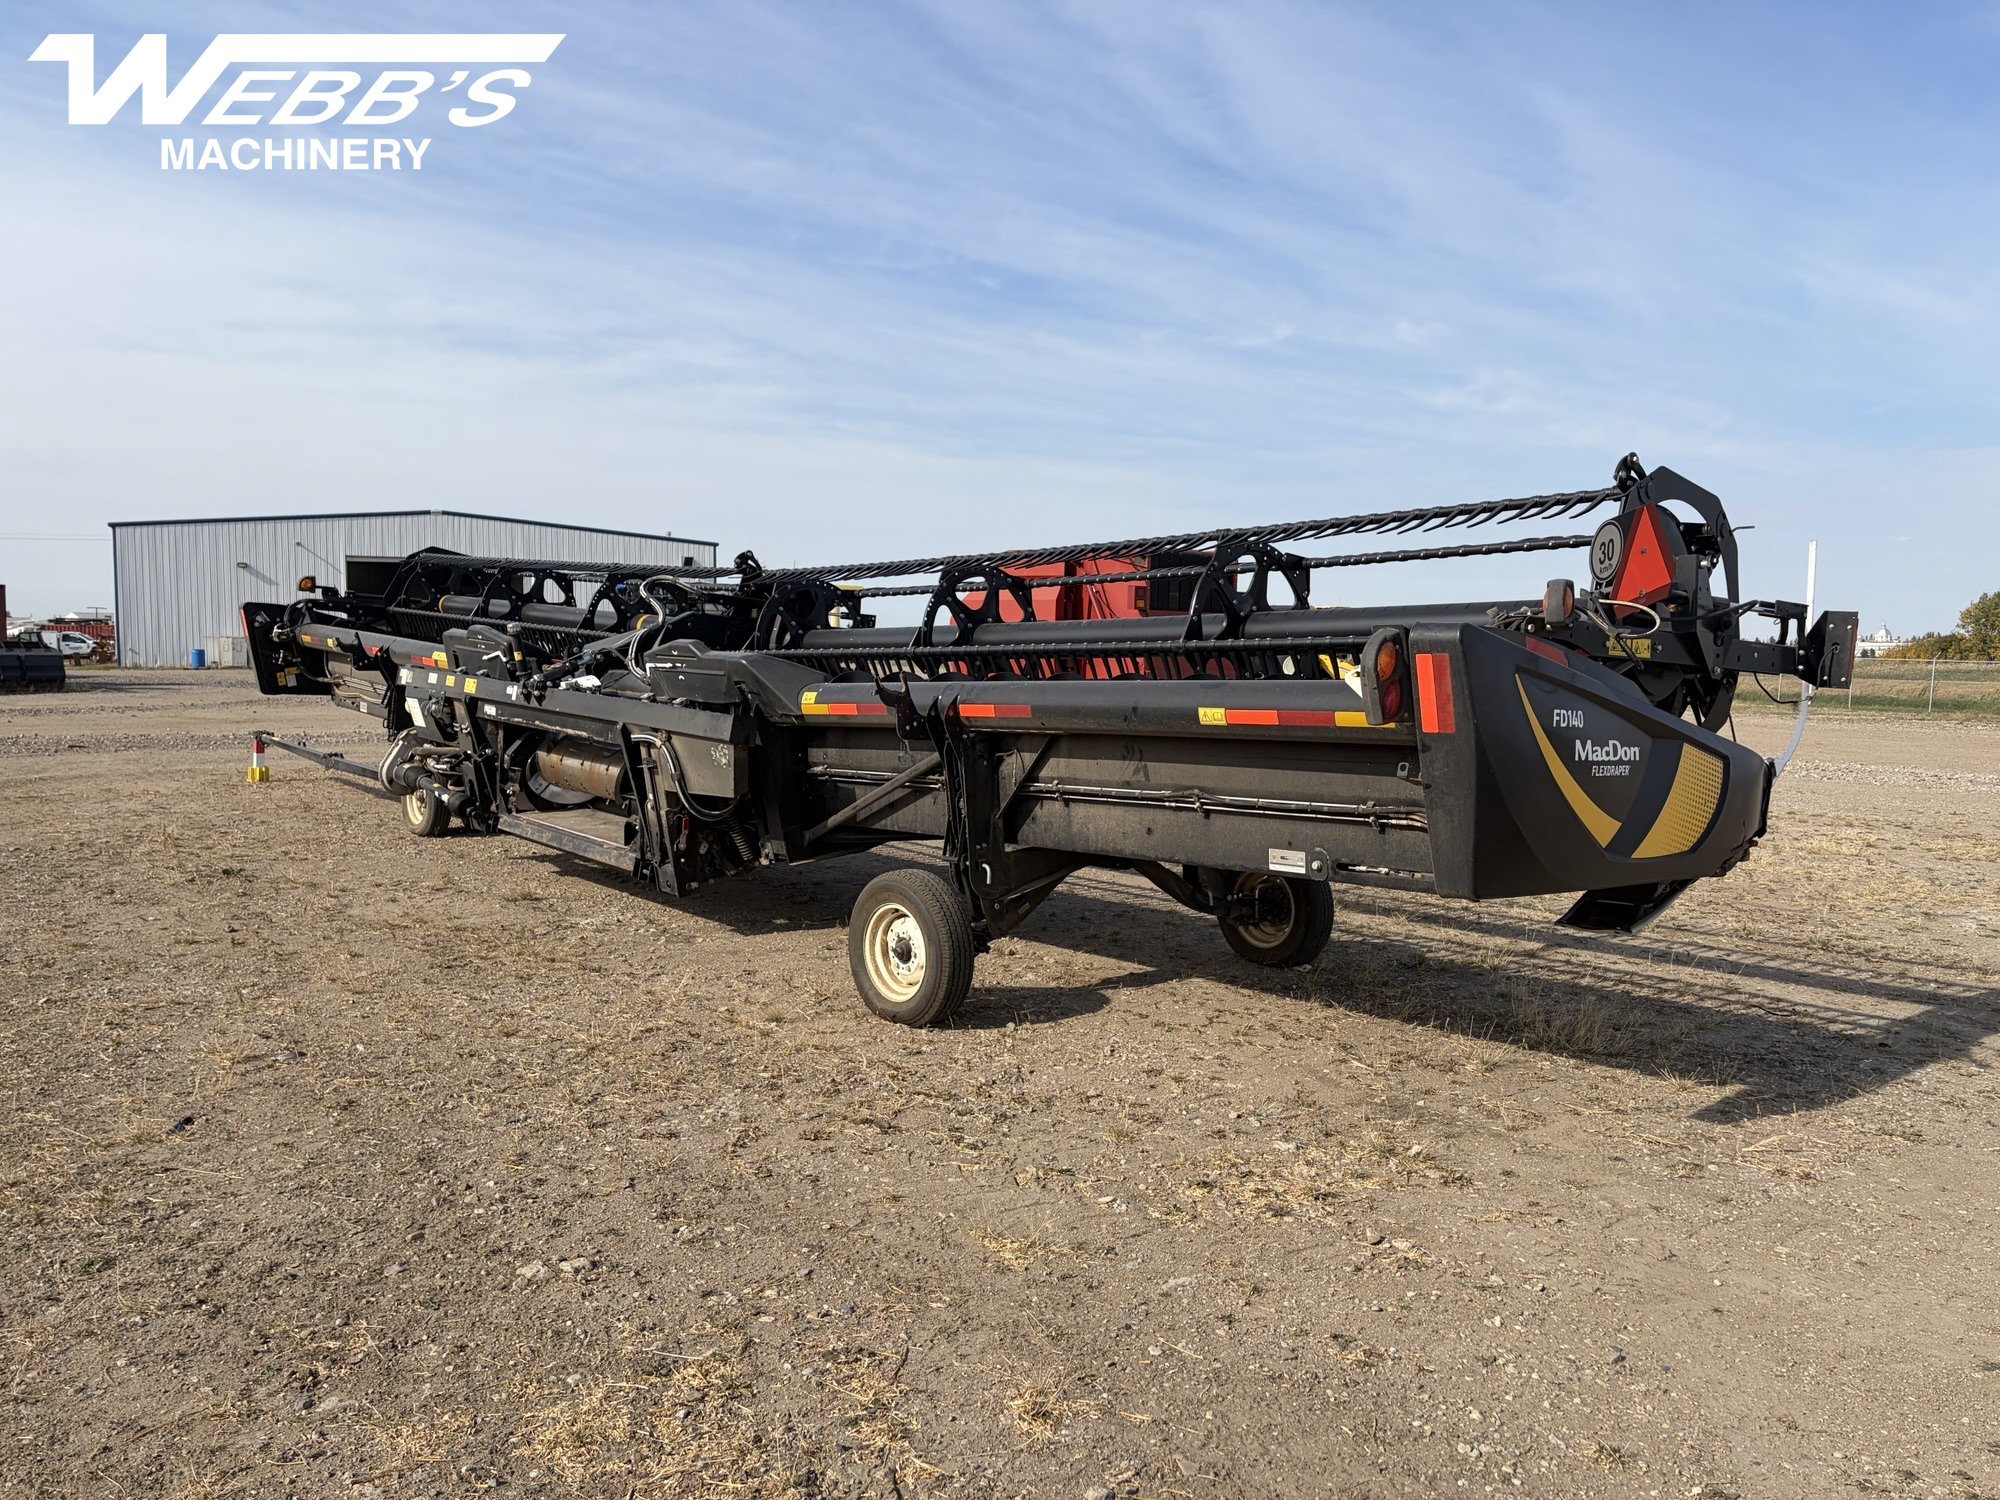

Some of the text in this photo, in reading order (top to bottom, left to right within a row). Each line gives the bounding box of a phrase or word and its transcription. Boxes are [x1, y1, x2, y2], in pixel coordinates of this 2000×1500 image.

[1598, 537, 1615, 566] 30
[1553, 709, 1584, 728] FD140
[1574, 739, 1640, 761] MacDon
[1591, 765, 1631, 777] FLEXDRAPER
